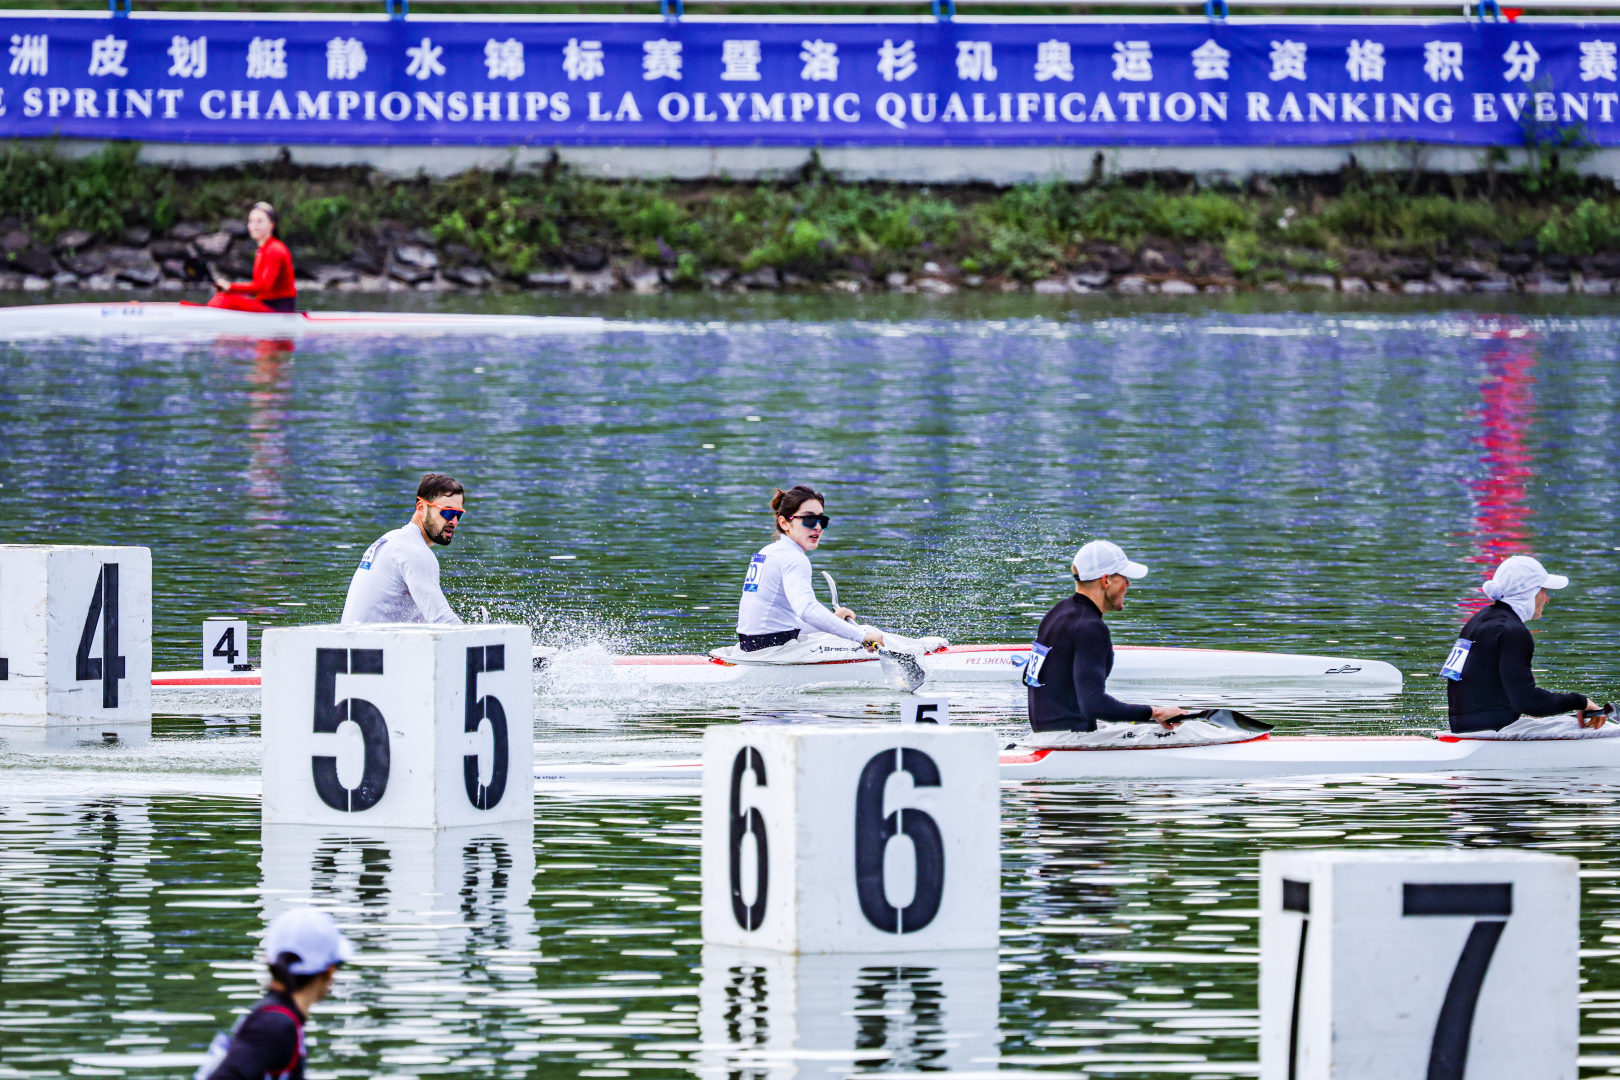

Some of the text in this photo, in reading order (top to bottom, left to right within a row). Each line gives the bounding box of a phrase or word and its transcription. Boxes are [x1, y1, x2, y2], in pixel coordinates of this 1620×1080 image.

[23, 87, 184, 119] SPRINT
[199, 89, 571, 122] CHAMPIONSHIPS
[588, 91, 643, 122] LA
[657, 92, 861, 123] OLYMPIC
[875, 91, 1228, 129] QUALIFICATION
[1246, 91, 1454, 123] RANKING
[1472, 91, 1619, 122] EVENT
[75, 563, 126, 708] 4
[213, 627, 239, 664] 4
[915, 704, 939, 725] 5
[311, 647, 391, 812] 5
[463, 644, 509, 811] 5
[730, 746, 769, 932] 6
[855, 747, 945, 935] 6
[1402, 883, 1513, 1080] 7
